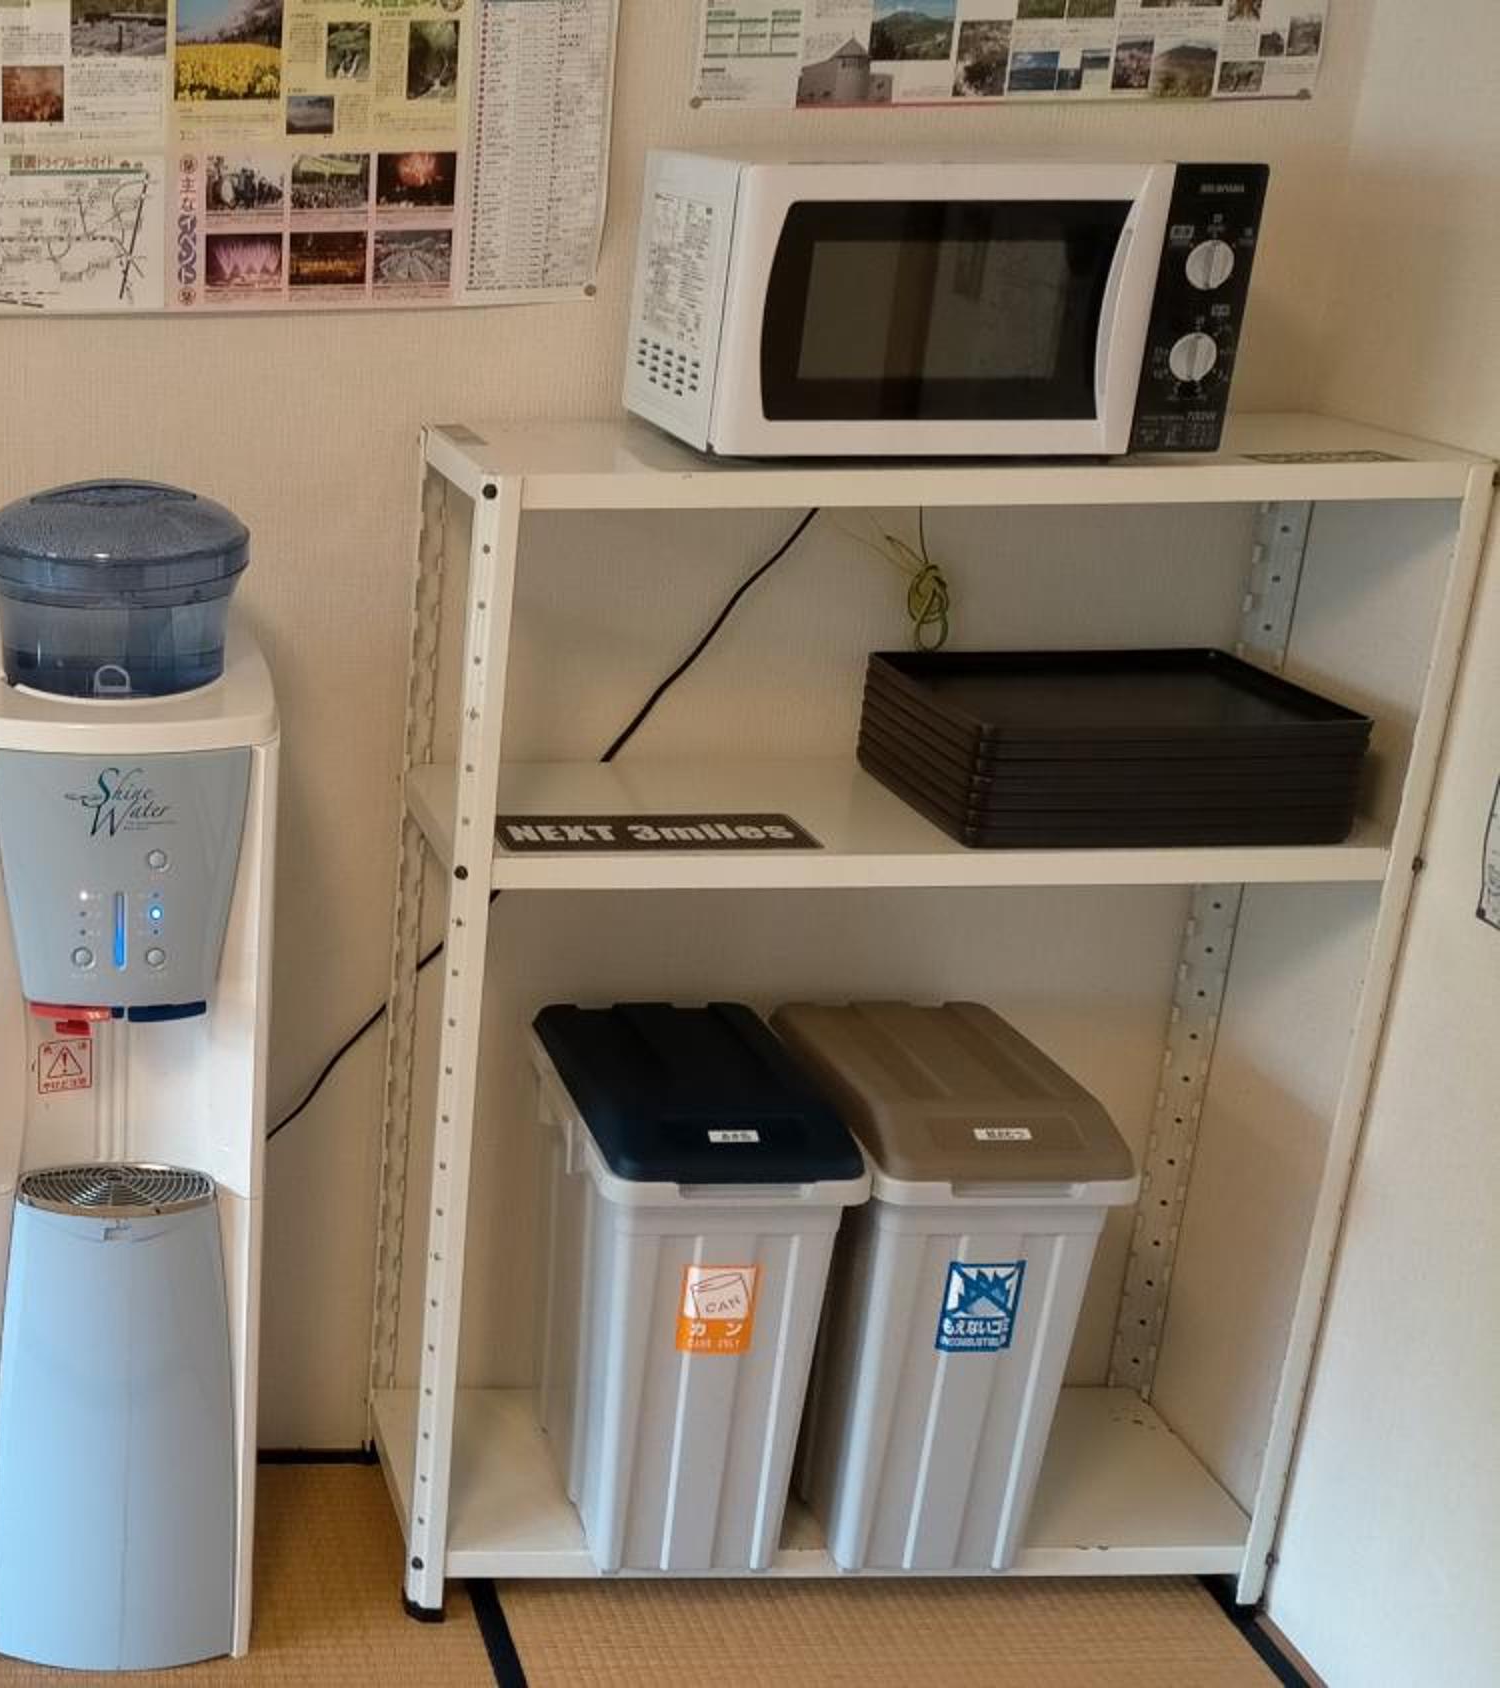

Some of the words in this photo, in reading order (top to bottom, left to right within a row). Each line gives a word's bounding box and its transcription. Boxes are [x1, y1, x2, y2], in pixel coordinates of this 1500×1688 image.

[90, 799, 172, 837] Water
[505, 825, 617, 841] NEXT
[627, 823, 795, 841] 3miles
[705, 1295, 741, 1312] CAN
[689, 1321, 743, 1337] カン
[942, 1316, 1011, 1336] もえないゴミ
